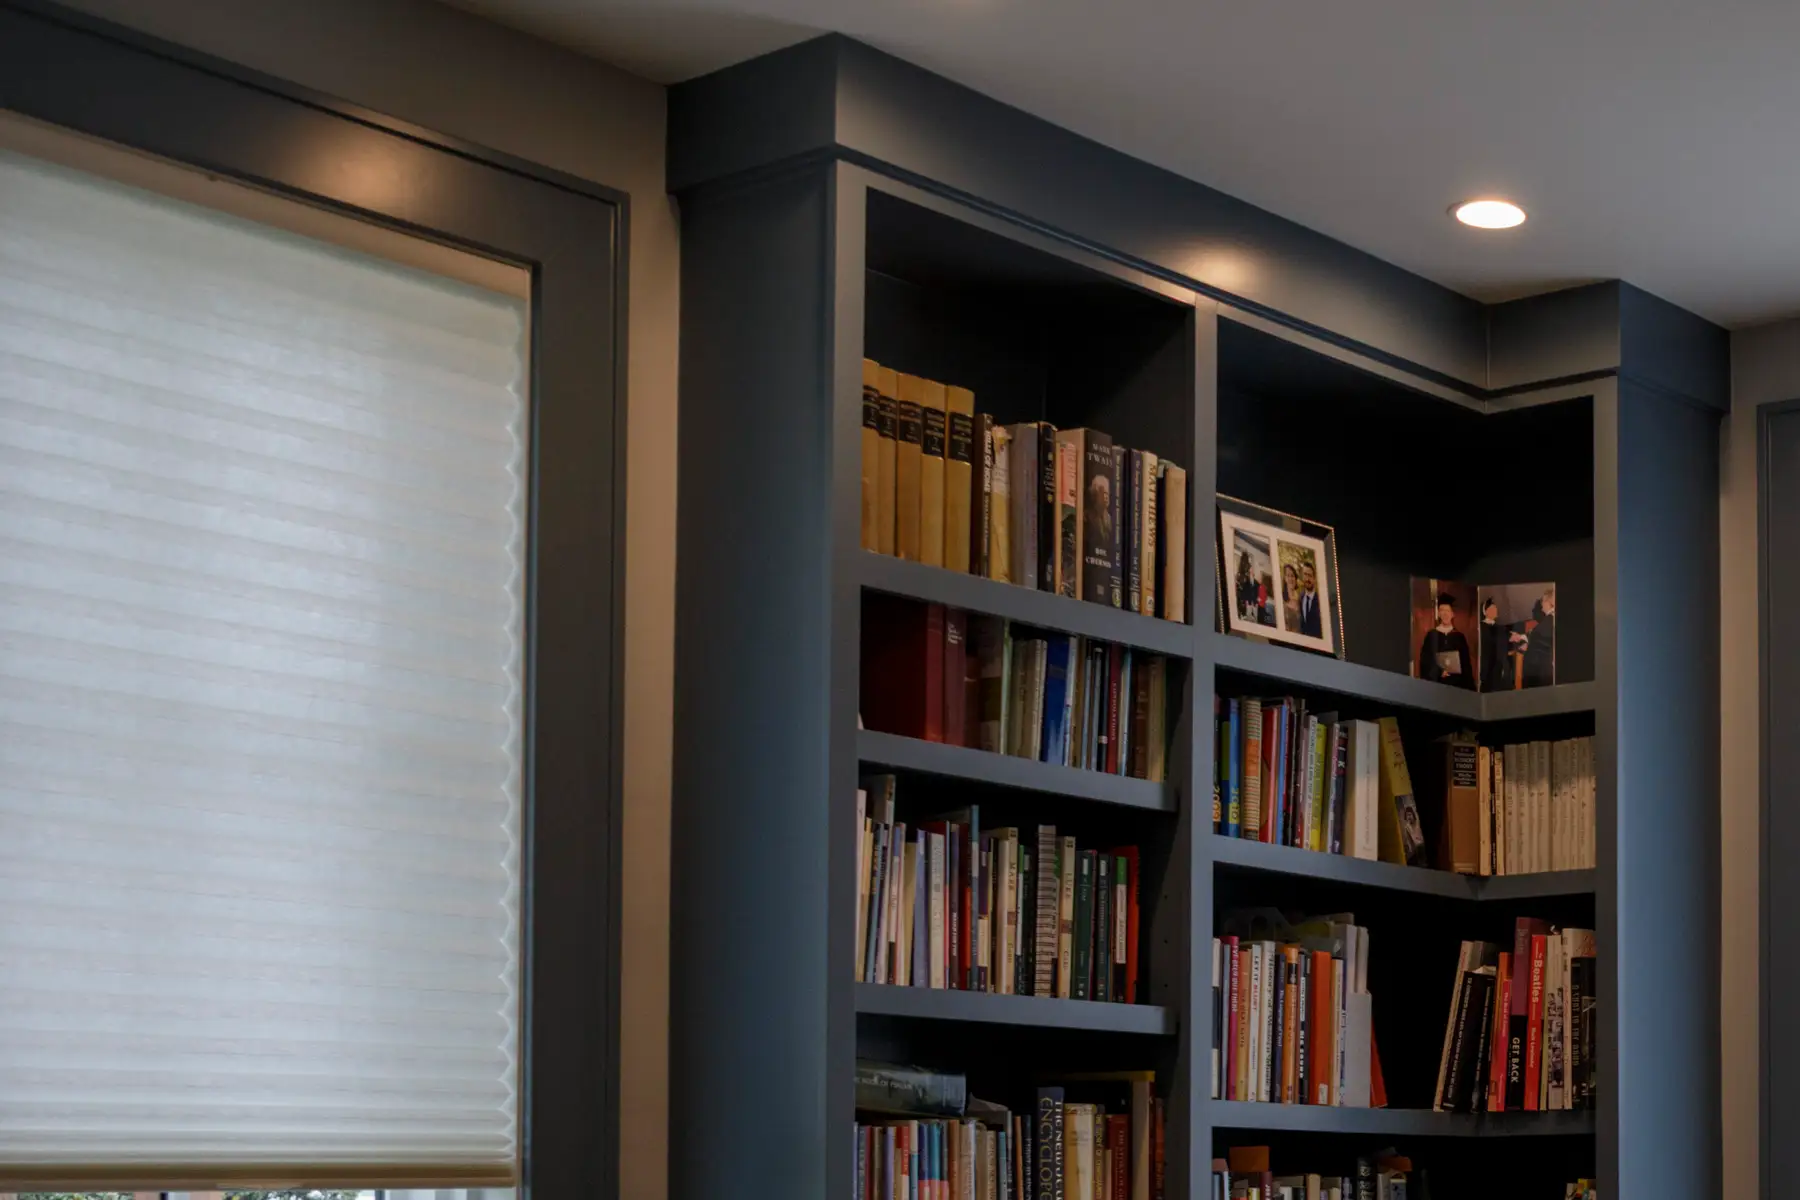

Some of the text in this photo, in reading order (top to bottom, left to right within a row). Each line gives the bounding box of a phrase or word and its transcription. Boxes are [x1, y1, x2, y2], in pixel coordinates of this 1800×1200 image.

[1148, 463, 1158, 548] MATTHEWS
[1530, 959, 1544, 1004] Beatles
[1509, 1036, 1521, 1084] GET BACK
[1054, 1100, 1064, 1129] THE
[1054, 1131, 1064, 1165] NEW
[1117, 1147, 1125, 1174] STORY
